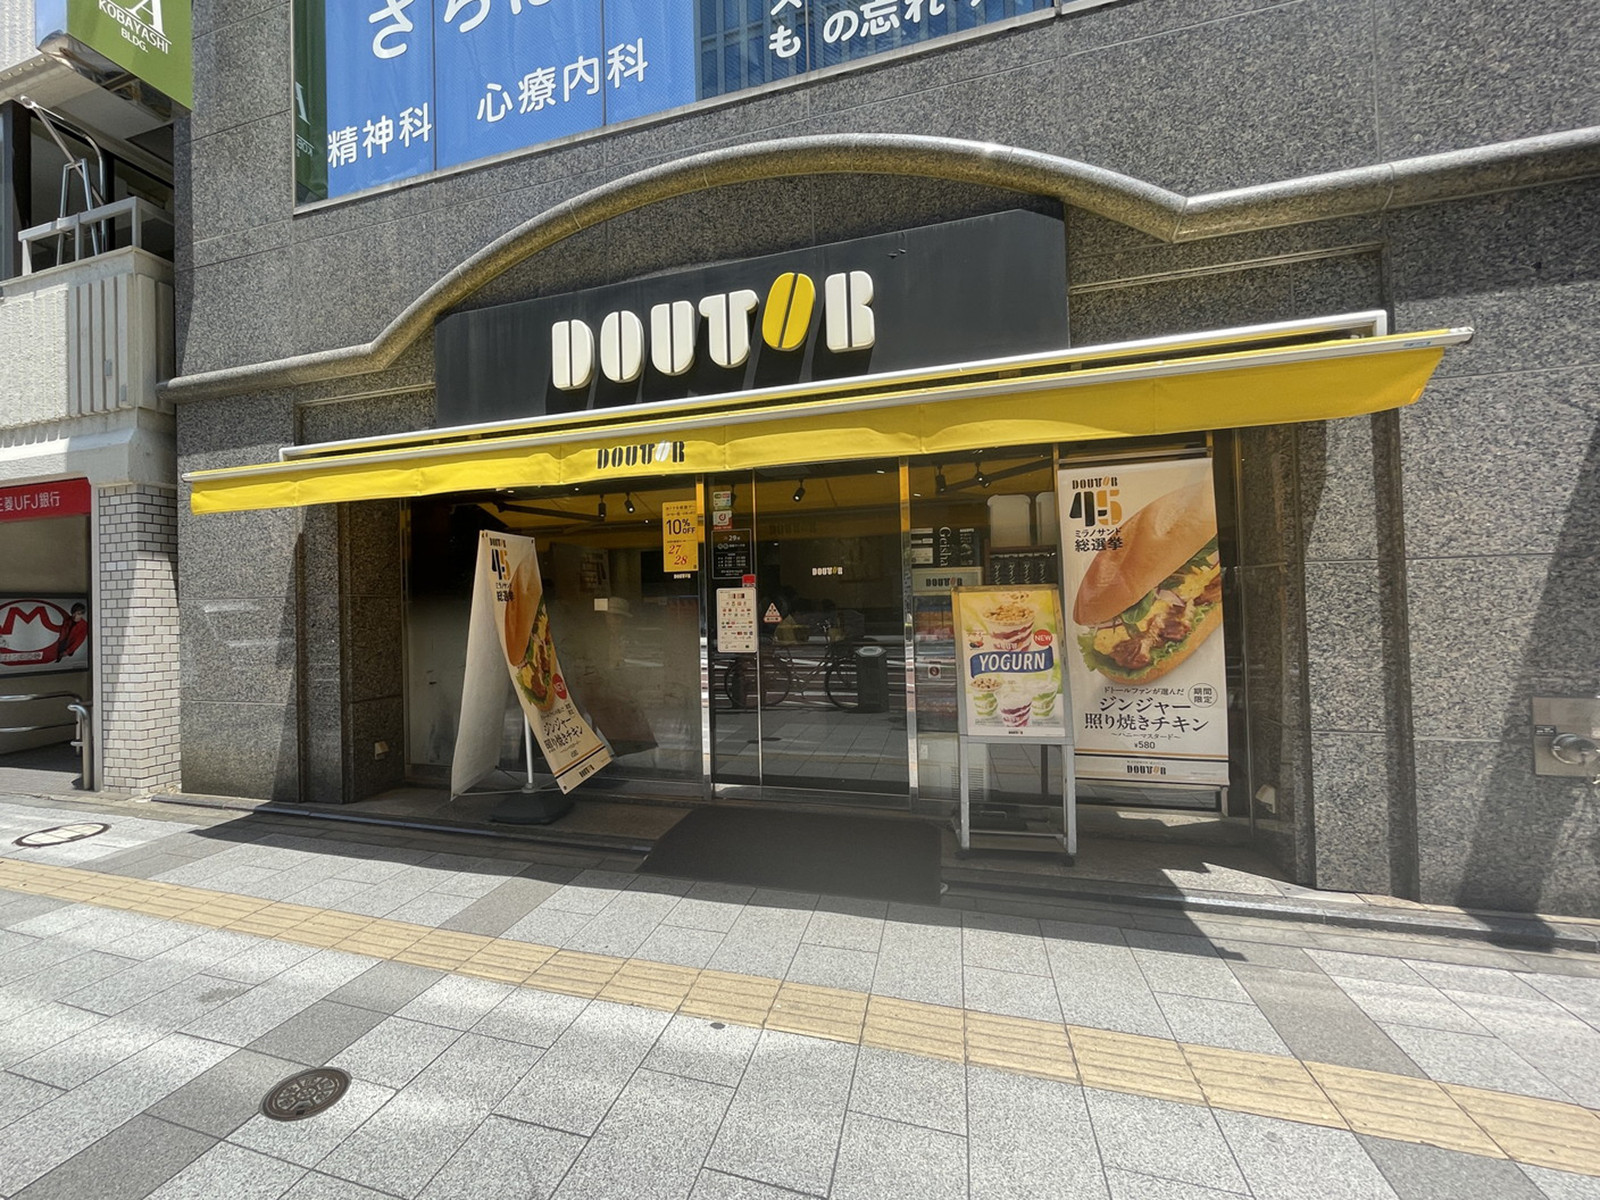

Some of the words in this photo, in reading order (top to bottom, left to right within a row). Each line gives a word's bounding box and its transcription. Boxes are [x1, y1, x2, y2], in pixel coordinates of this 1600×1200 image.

[99, 0, 169, 55] KOBAYASHI
[120, 27, 149, 53] BLDG.
[327, 102, 433, 169] 精神科
[476, 38, 649, 123] 心療内科
[551, 270, 876, 391] DOUTOR
[597, 440, 685, 470] DOUTOR
[1072, 475, 1118, 490] DOUTOR
[1075, 526, 1122, 538] ミラノサンド
[1075, 536, 1124, 552] 総選挙
[1034, 633, 1053, 642] NEW
[979, 652, 1046, 672] YOGURN
[1099, 695, 1192, 716] ジンジャー
[1084, 713, 1209, 733] 照り焼きチキン
